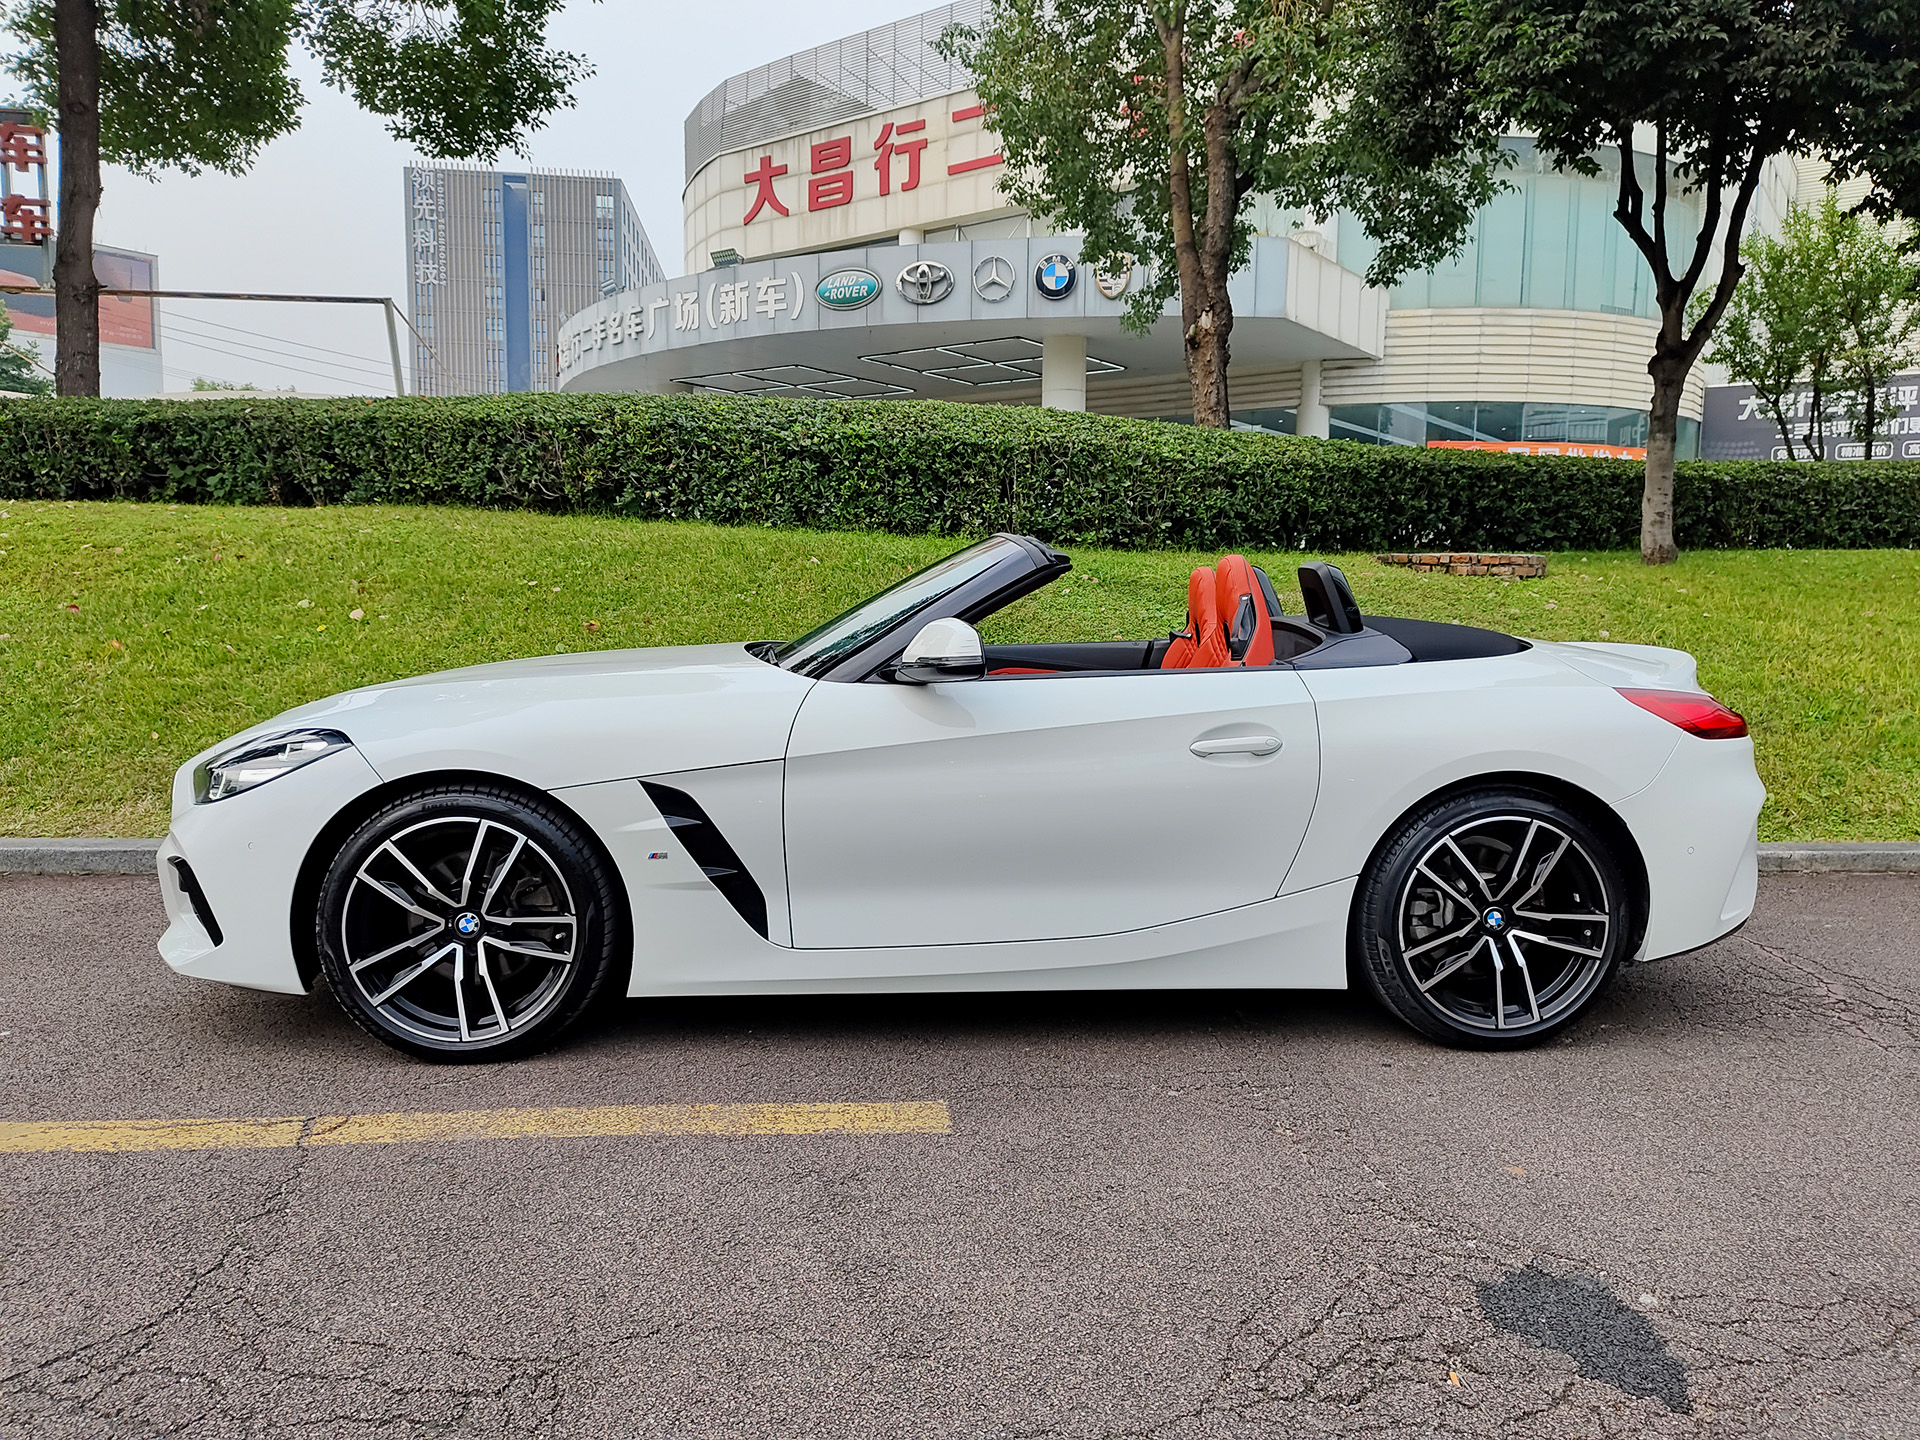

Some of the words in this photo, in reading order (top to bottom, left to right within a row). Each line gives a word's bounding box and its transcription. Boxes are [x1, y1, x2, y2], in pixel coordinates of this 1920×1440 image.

[743, 105, 1003, 226] 大昌行二
[411, 166, 440, 285] 领先科技
[827, 275, 857, 289] LAND
[830, 285, 868, 300] ROVER
